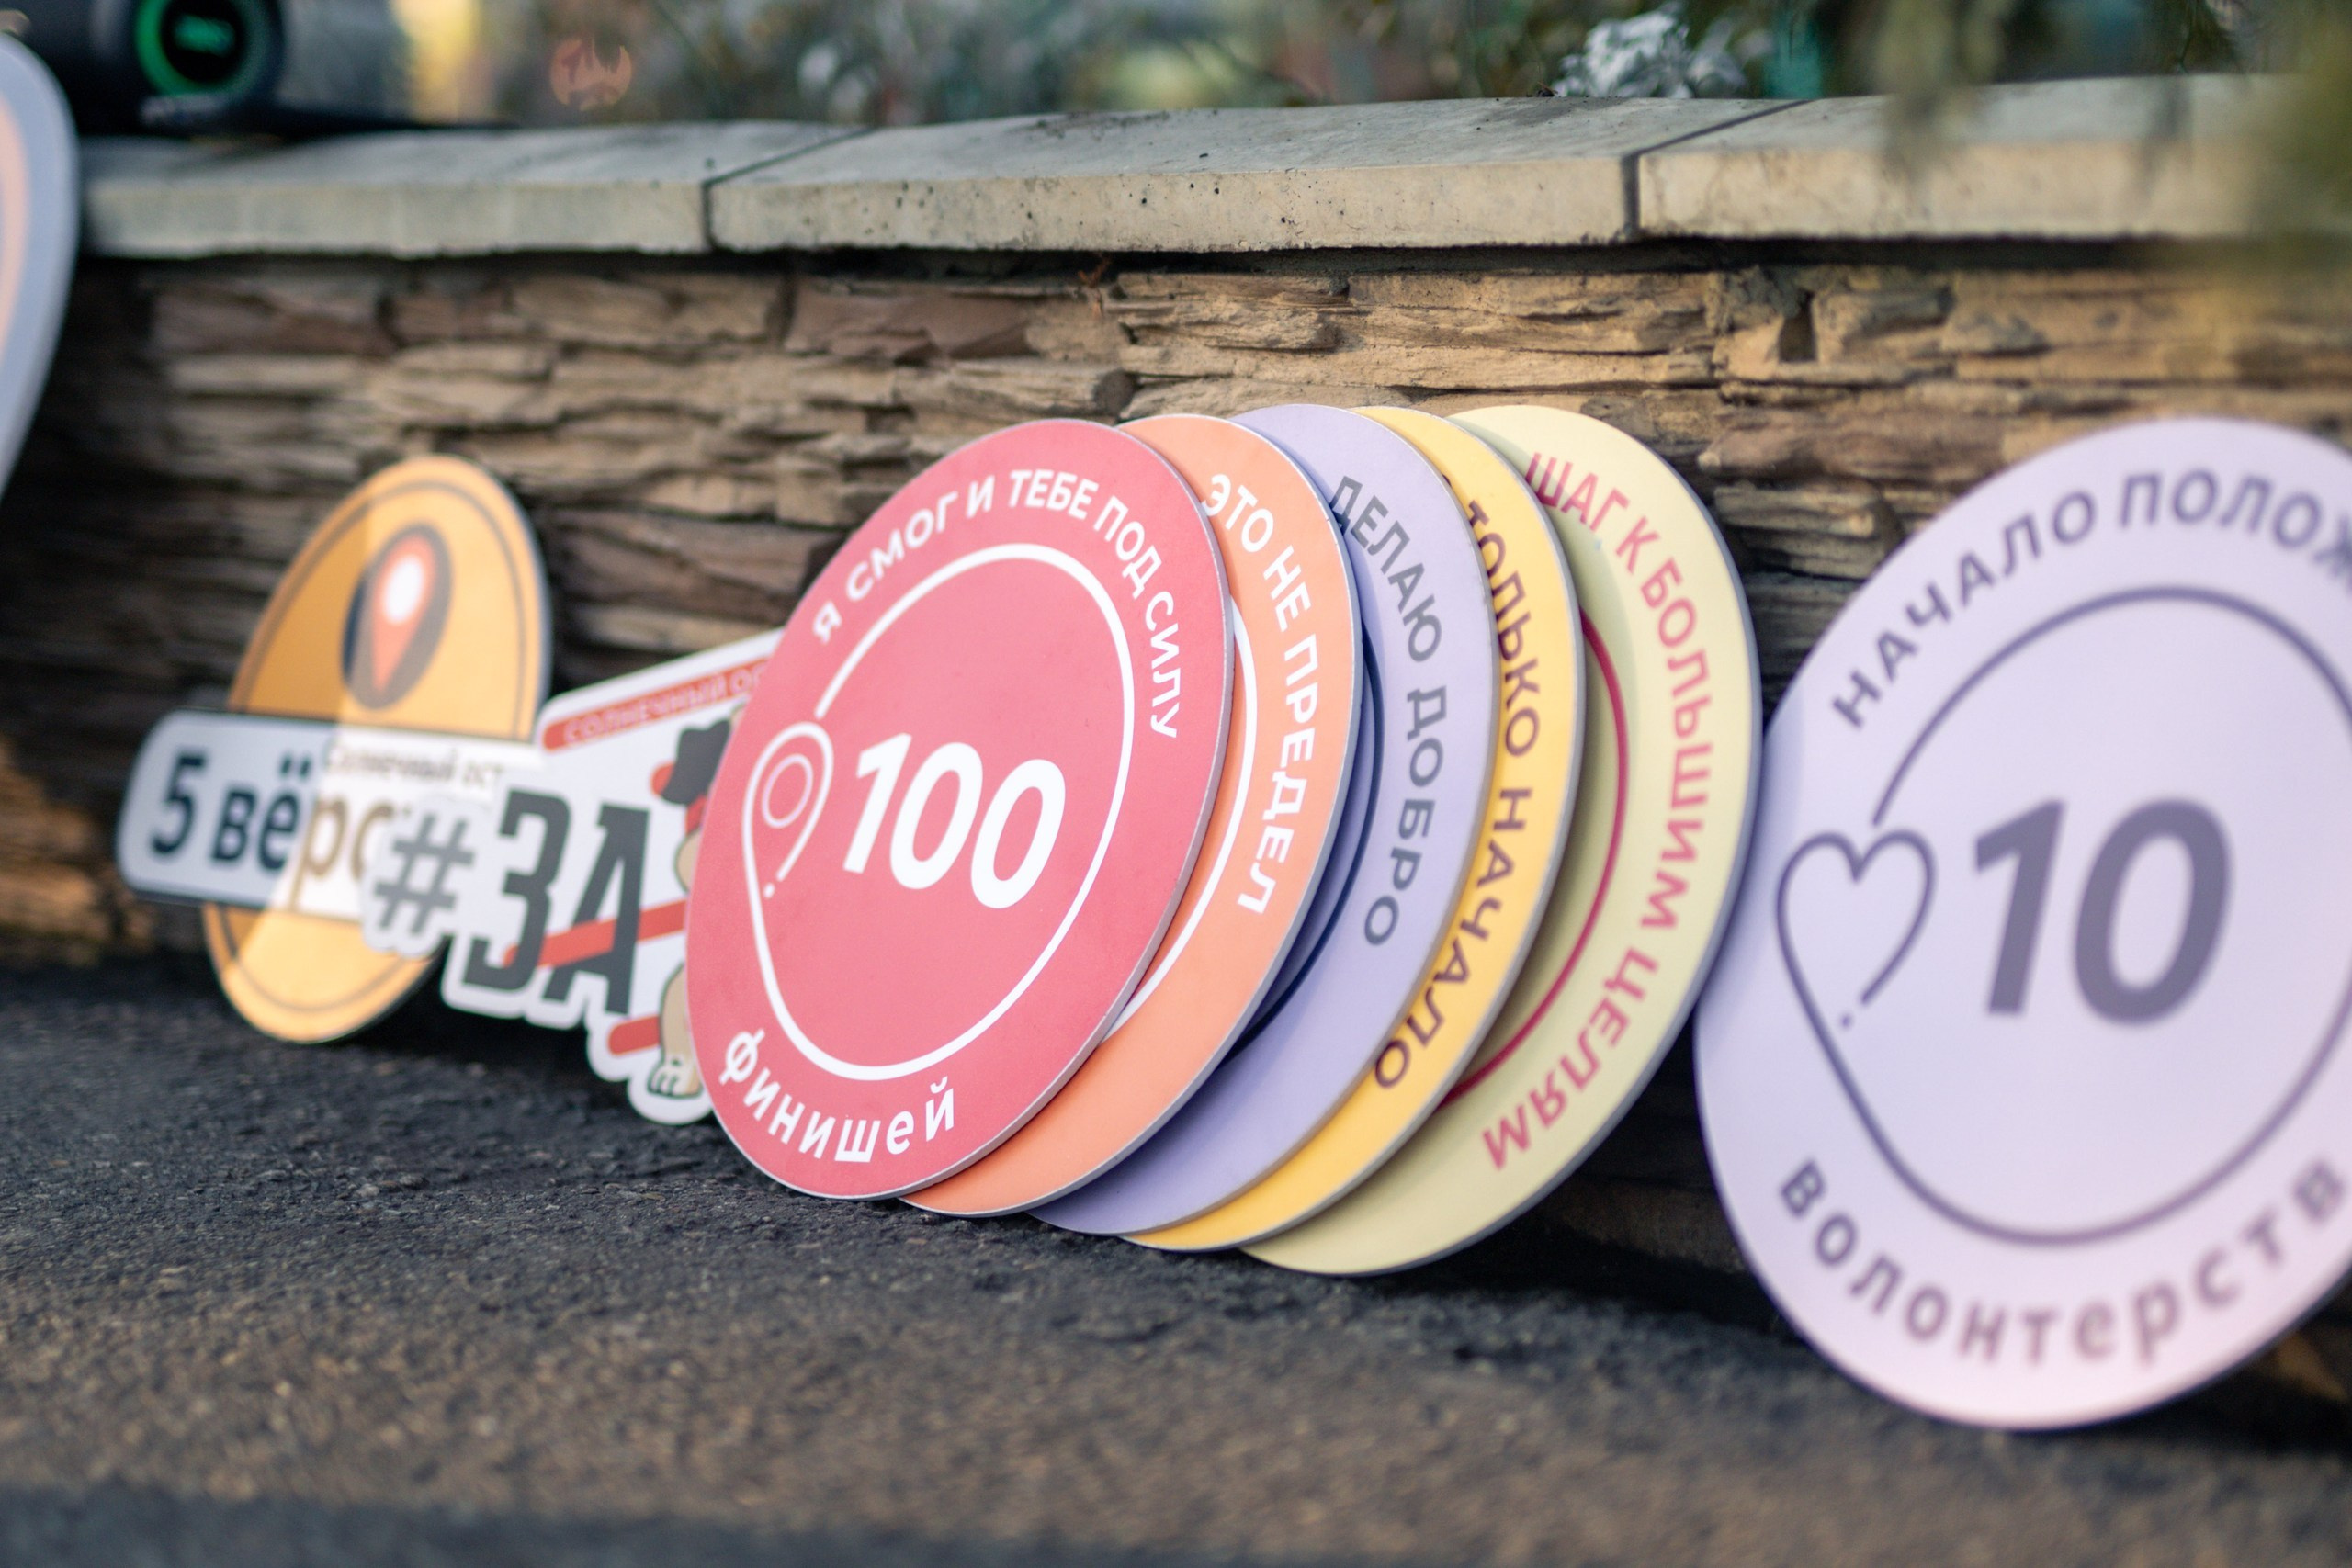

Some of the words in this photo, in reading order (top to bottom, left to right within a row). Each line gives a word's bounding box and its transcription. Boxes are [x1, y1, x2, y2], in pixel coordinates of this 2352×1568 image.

[1201, 474, 1274, 553] ЭТО
[1262, 545, 1311, 633] НЕ
[1329, 475, 1442, 663] ДЕЛАЮ
[1525, 452, 1630, 532] ШАГ
[1615, 515, 1661, 576] К
[812, 600, 843, 644] Я
[845, 491, 959, 602] СМОГ
[966, 474, 996, 519] И
[1009, 469, 1099, 520] ТЕБЕ
[1093, 496, 1162, 599] ПОД
[1145, 591, 1182, 739] СИЛУ
[1833, 491, 2098, 728] НАЧАЛО
[152, 750, 208, 860] 5
[211, 751, 412, 911] вёрс
[842, 732, 1066, 910] 100
[1237, 633, 1319, 915] ПРЕДЕЛ
[1363, 684, 1448, 946] ДОБРО
[1640, 556, 1713, 930] БОЛЬШИМ
[1374, 787, 1532, 1090] НАЧАЛО
[1973, 797, 2233, 1029] 10
[718, 1028, 954, 1163] финишей
[1482, 948, 1658, 1170] ЦЕЛЯМ
